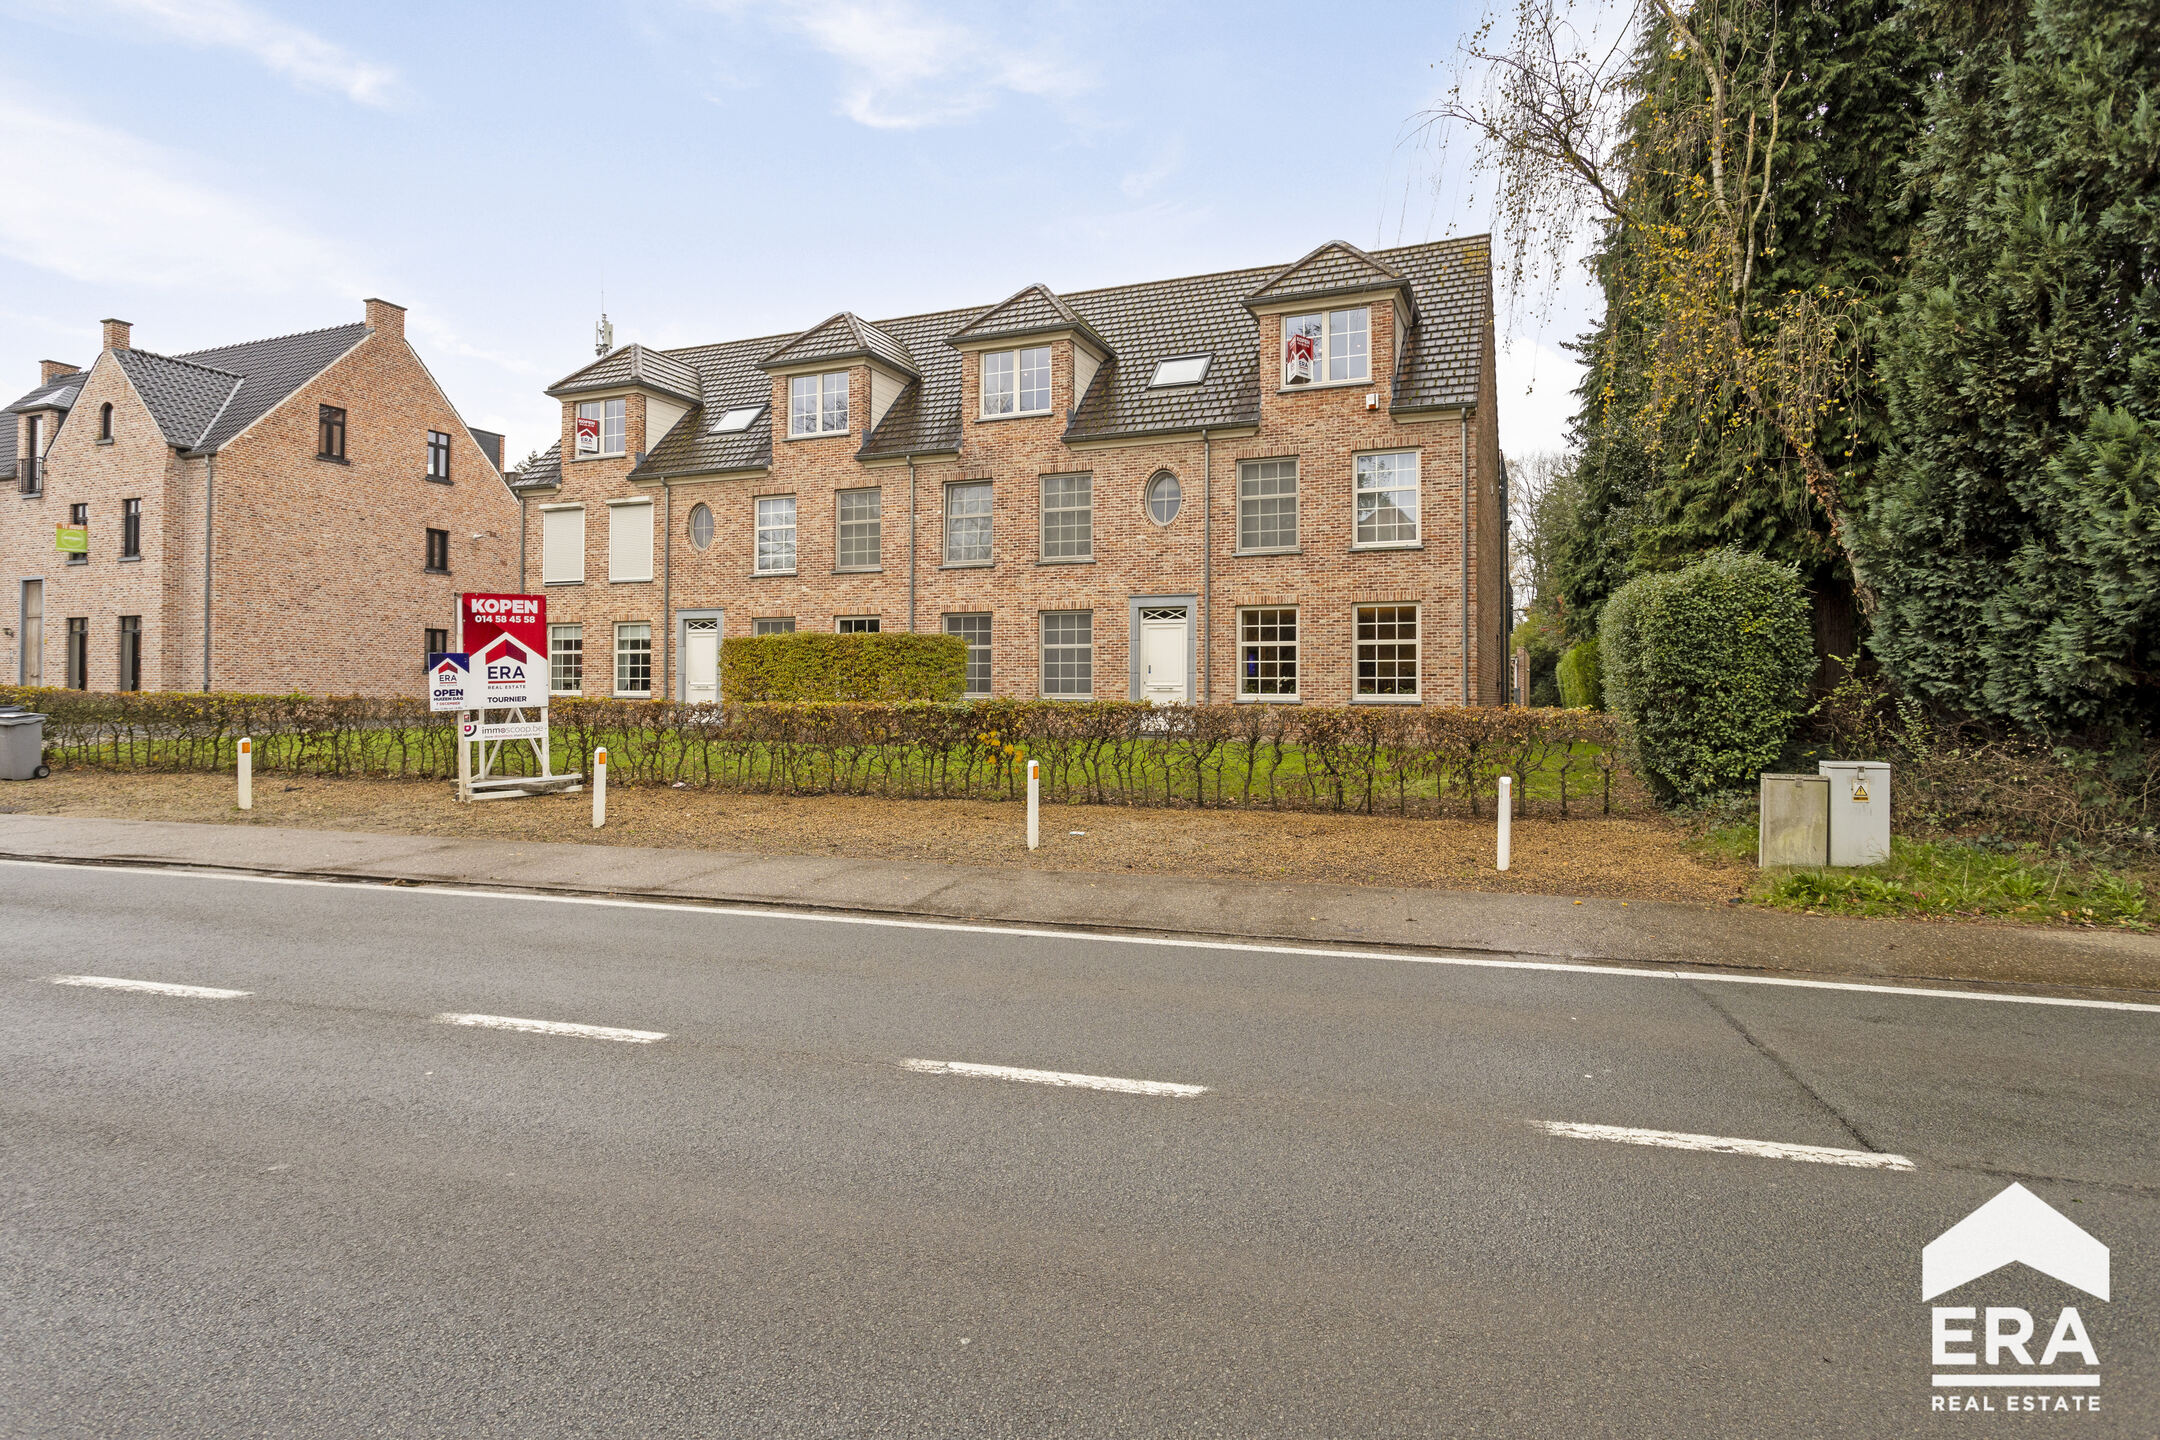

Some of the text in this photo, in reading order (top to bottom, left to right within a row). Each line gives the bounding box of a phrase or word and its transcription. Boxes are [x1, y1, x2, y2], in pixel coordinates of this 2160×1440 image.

[471, 598, 538, 614] KOPEN
[474, 615, 536, 623] 014 58 45 58
[487, 666, 526, 680] ERA
[439, 674, 457, 682] ERA
[433, 689, 464, 697] OPEN
[487, 695, 527, 703] TOURNIER
[482, 725, 544, 734] immoscoop.be
